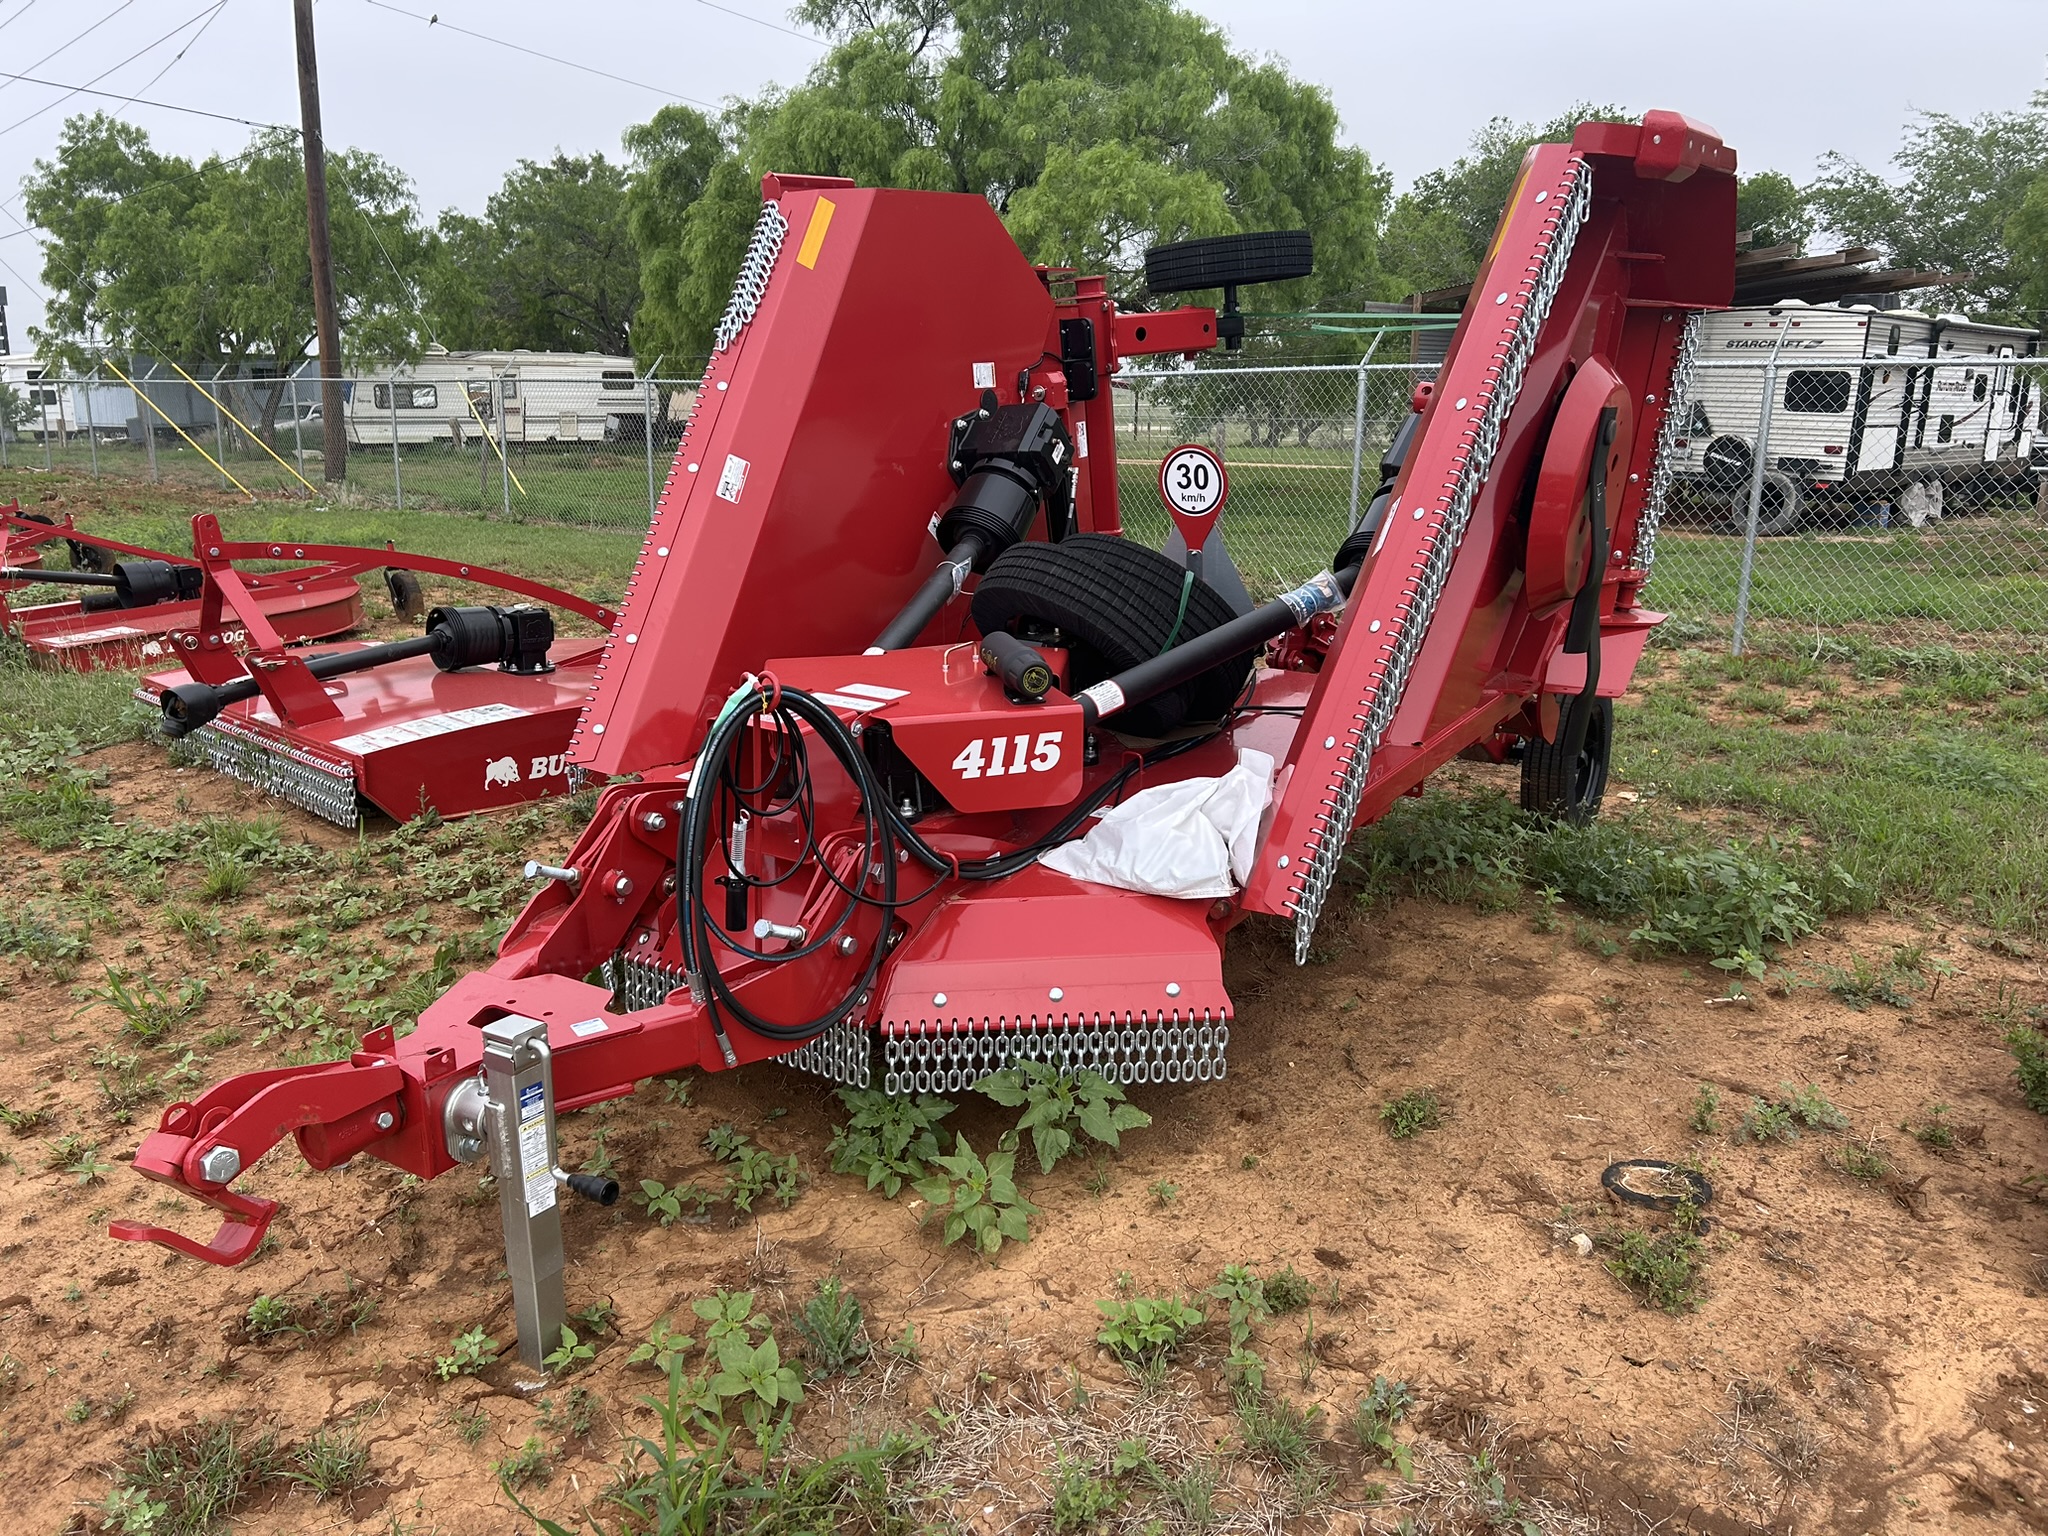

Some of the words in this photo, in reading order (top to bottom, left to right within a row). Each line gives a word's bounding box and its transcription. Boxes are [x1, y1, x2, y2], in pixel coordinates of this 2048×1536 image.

[1176, 463, 1209, 490] 30
[1181, 493, 1206, 502] km/h
[221, 629, 245, 644] OG
[528, 754, 568, 779] BU
[951, 731, 1063, 779] 4115
